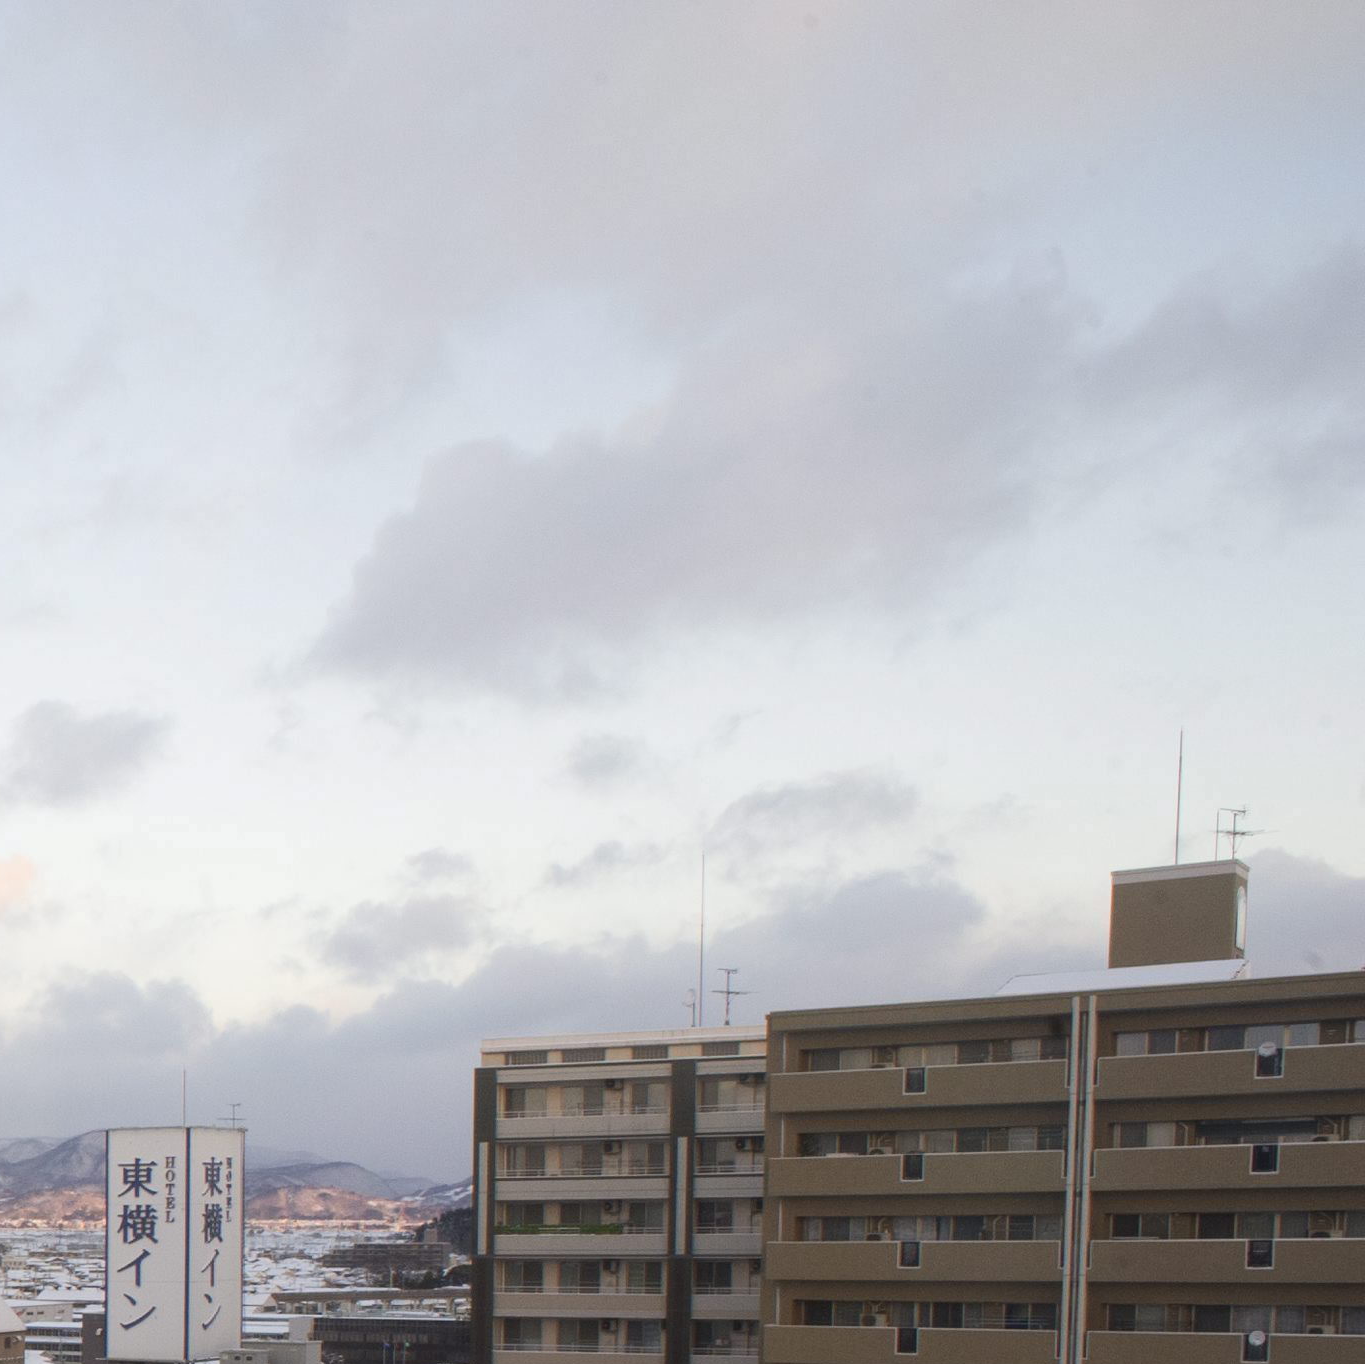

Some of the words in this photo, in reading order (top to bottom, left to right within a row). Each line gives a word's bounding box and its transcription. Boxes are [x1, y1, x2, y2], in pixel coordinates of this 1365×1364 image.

[117, 1157, 159, 1330] 東横イン
[165, 1156, 176, 1223] HOTEL
[201, 1156, 223, 1330] 東横イン
[225, 1157, 233, 1222] HOTEL
